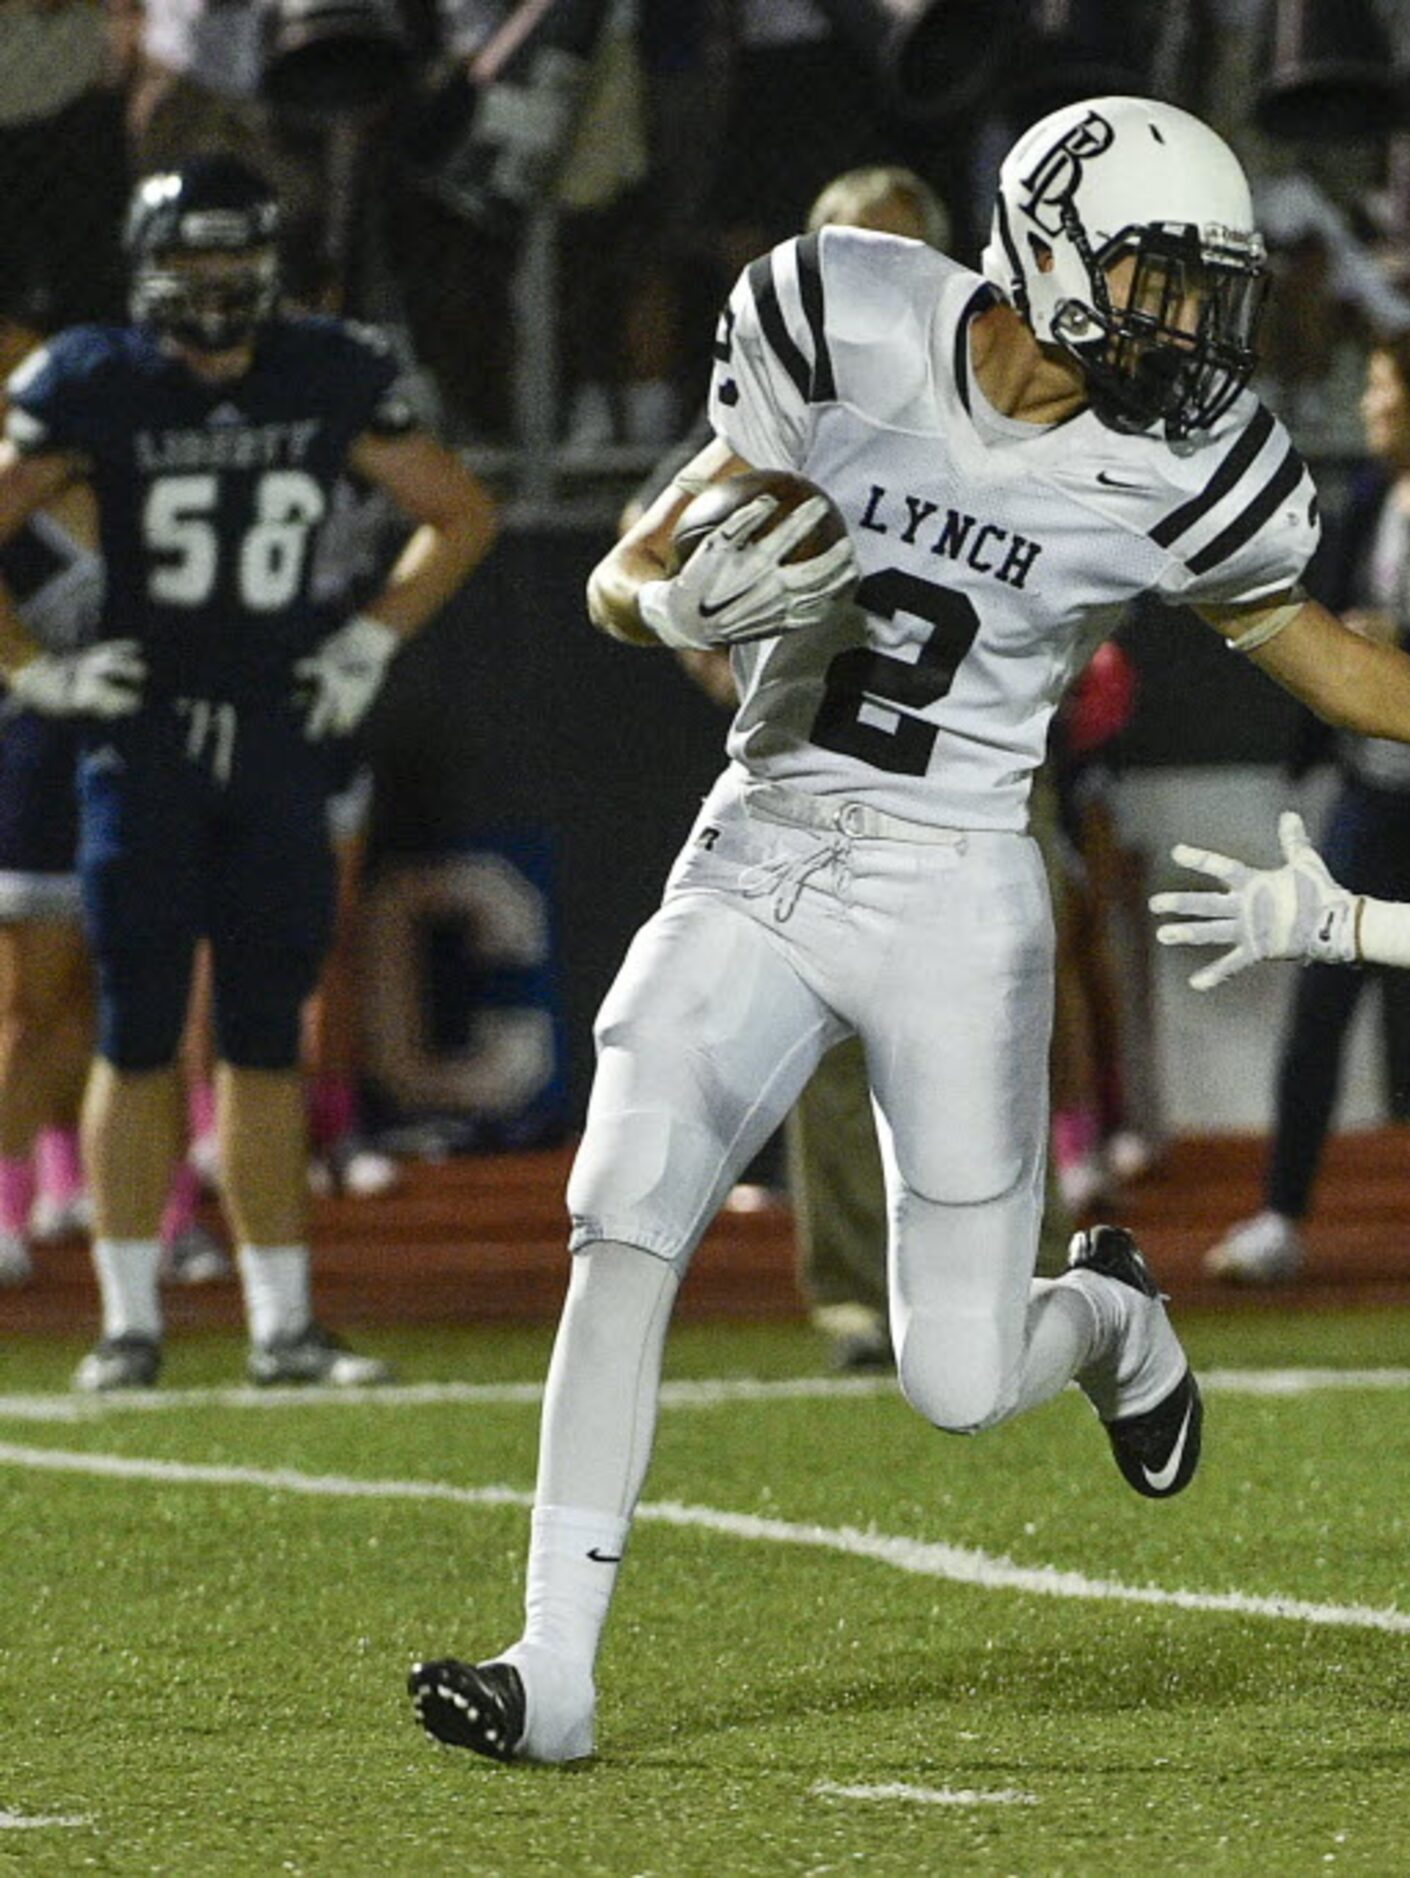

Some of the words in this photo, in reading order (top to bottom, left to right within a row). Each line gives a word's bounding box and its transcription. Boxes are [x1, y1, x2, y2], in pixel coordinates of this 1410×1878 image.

[144, 472, 325, 609] 58
[858, 484, 1043, 590] LYNCH
[808, 566, 982, 778] 2
